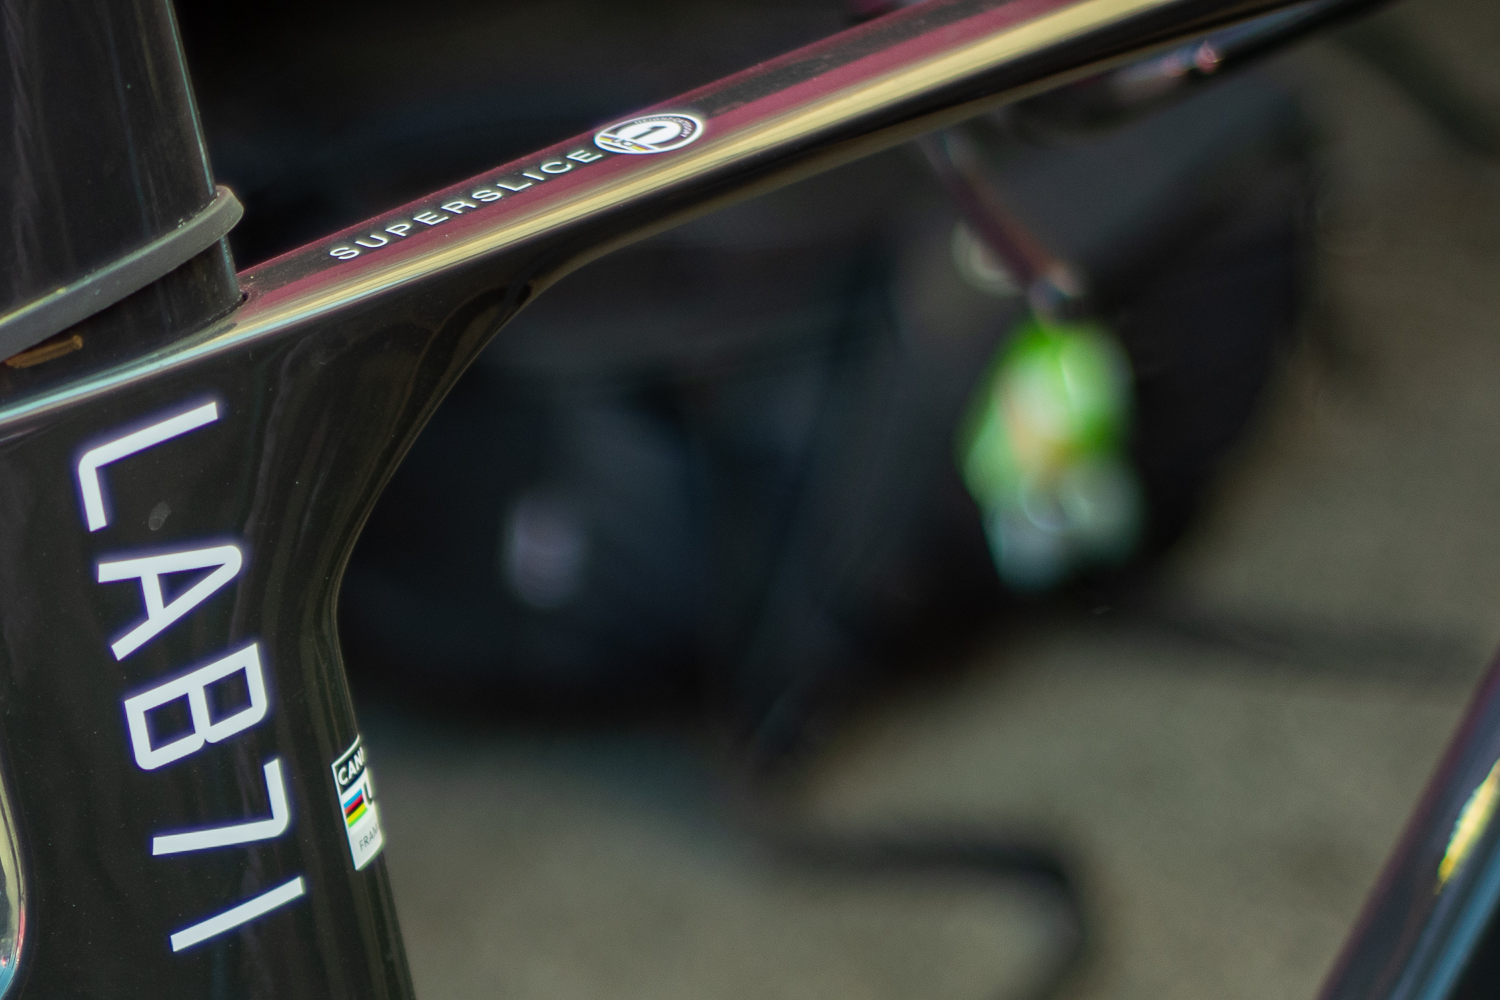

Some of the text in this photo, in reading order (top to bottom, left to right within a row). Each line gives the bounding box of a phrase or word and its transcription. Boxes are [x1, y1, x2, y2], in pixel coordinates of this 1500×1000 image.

[631, 125, 667, 140] 1
[329, 149, 603, 260] SUPERSLICE
[78, 401, 305, 952] LAB71
